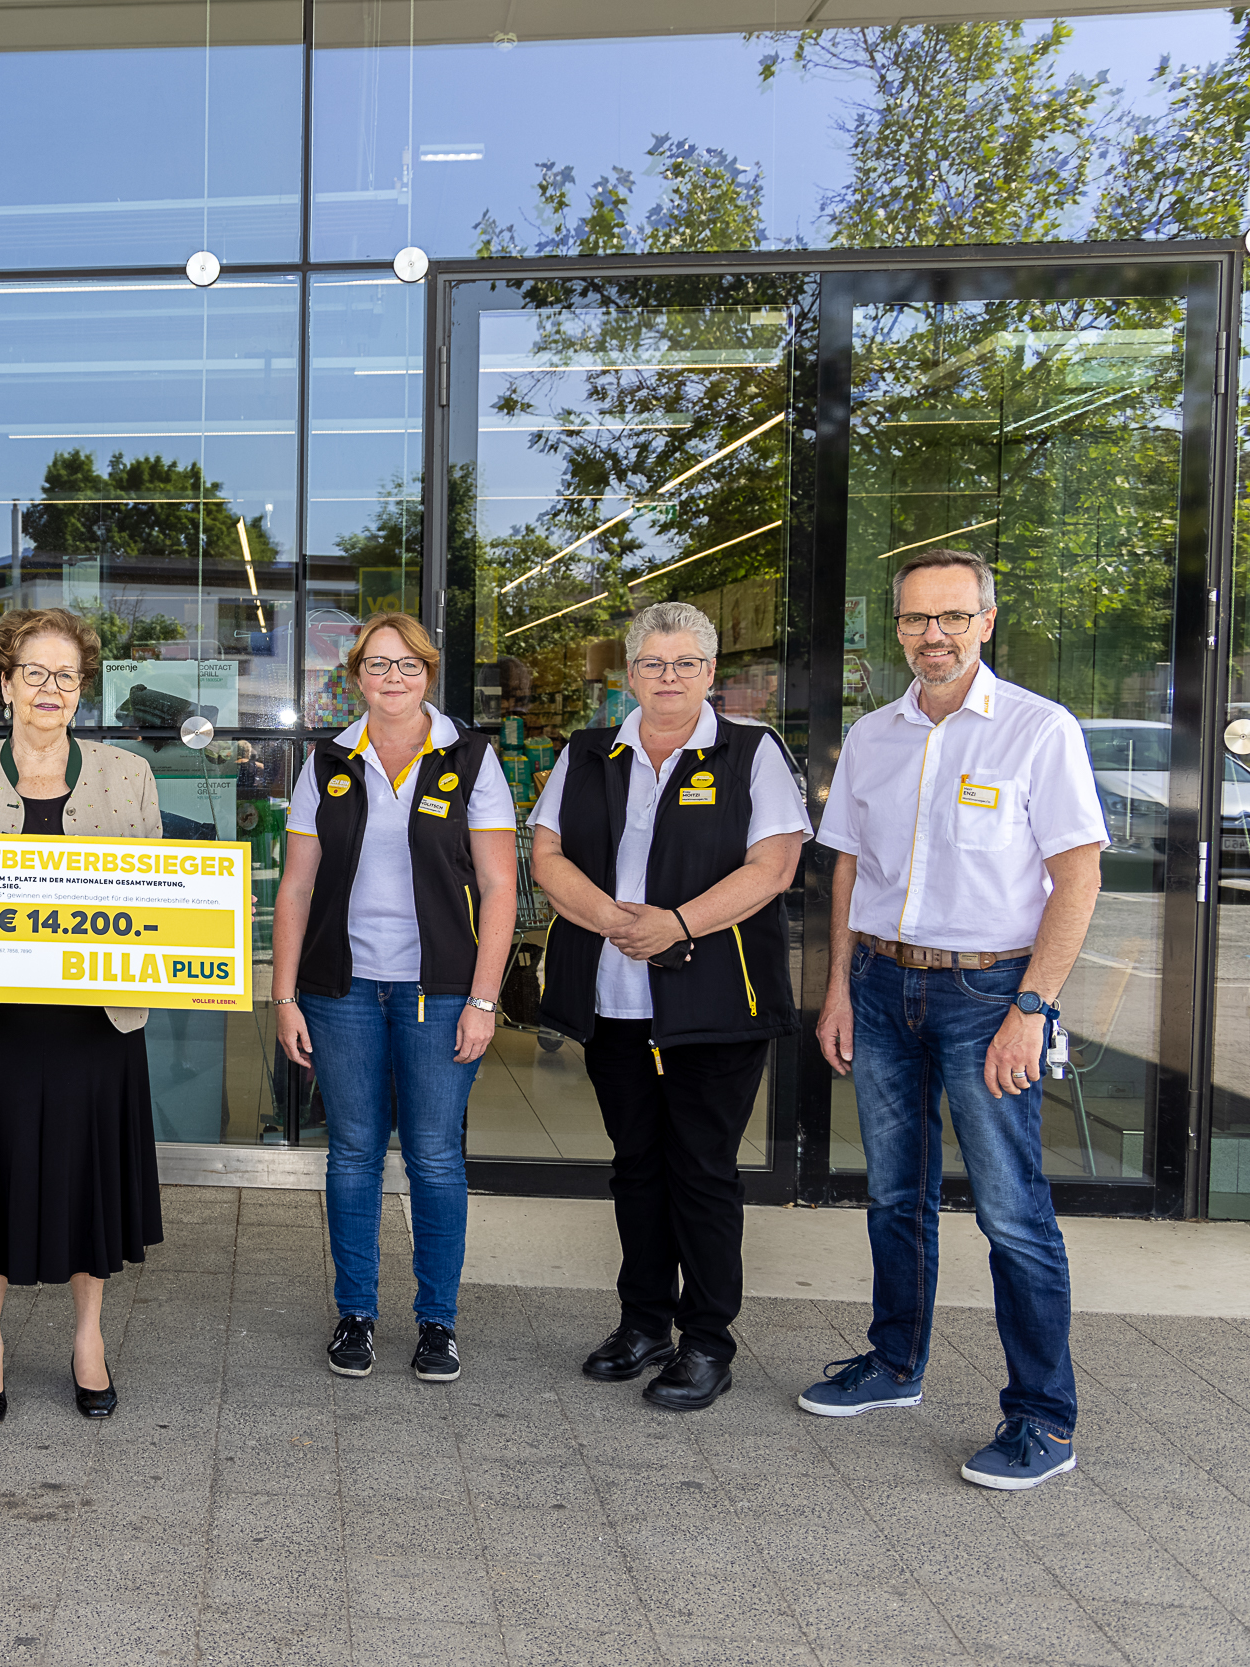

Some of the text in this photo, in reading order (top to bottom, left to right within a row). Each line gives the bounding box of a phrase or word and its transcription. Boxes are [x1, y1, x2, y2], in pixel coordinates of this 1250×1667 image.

[106, 663, 138, 672] gorenje
[115, 879, 186, 888] GESAMTWERTUNG,
[54, 893, 110, 902] Spendenbudget
[135, 896, 190, 904] Kinderkrebshilfe
[62, 950, 230, 984] BILLA PLUS
